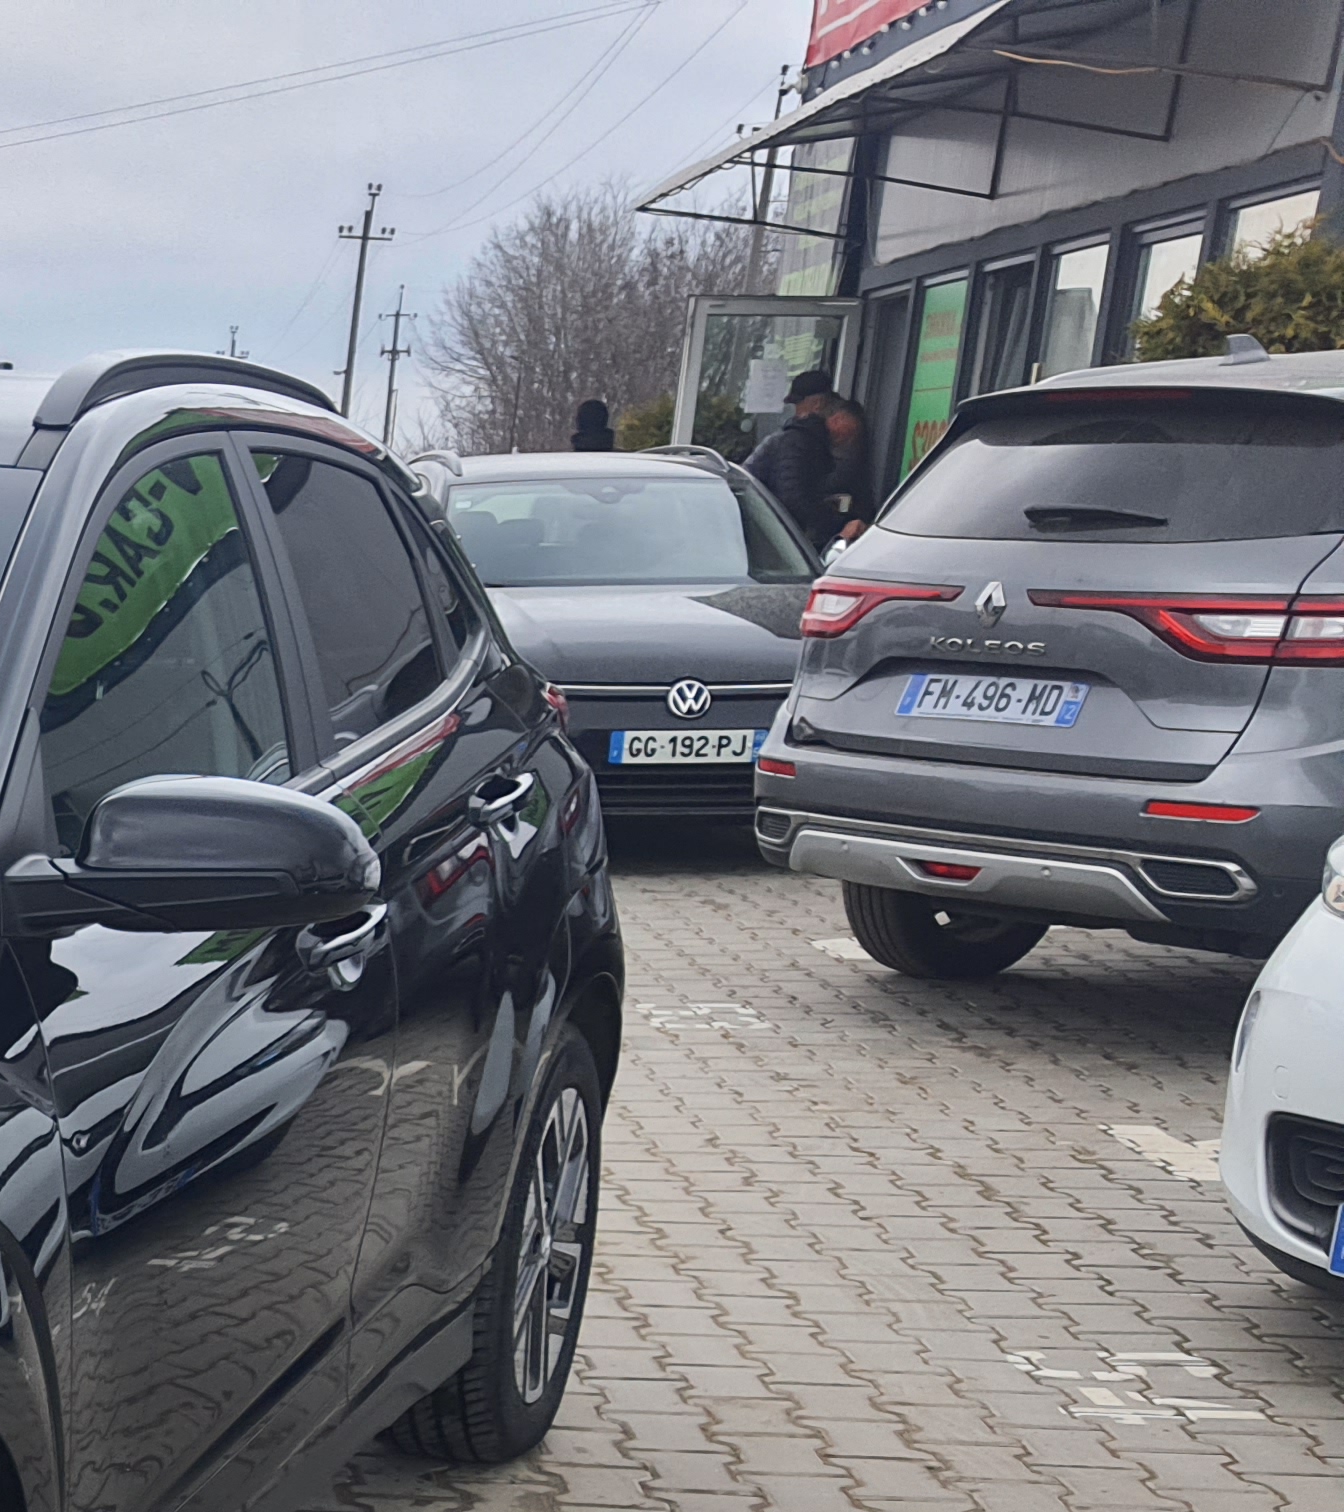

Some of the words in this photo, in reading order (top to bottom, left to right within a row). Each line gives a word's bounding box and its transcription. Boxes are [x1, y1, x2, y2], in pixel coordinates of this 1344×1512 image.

[930, 636, 1047, 656] KOLEOS
[917, 677, 1064, 717] FM-496-MD
[628, 735, 748, 758] GG-192-PJ
